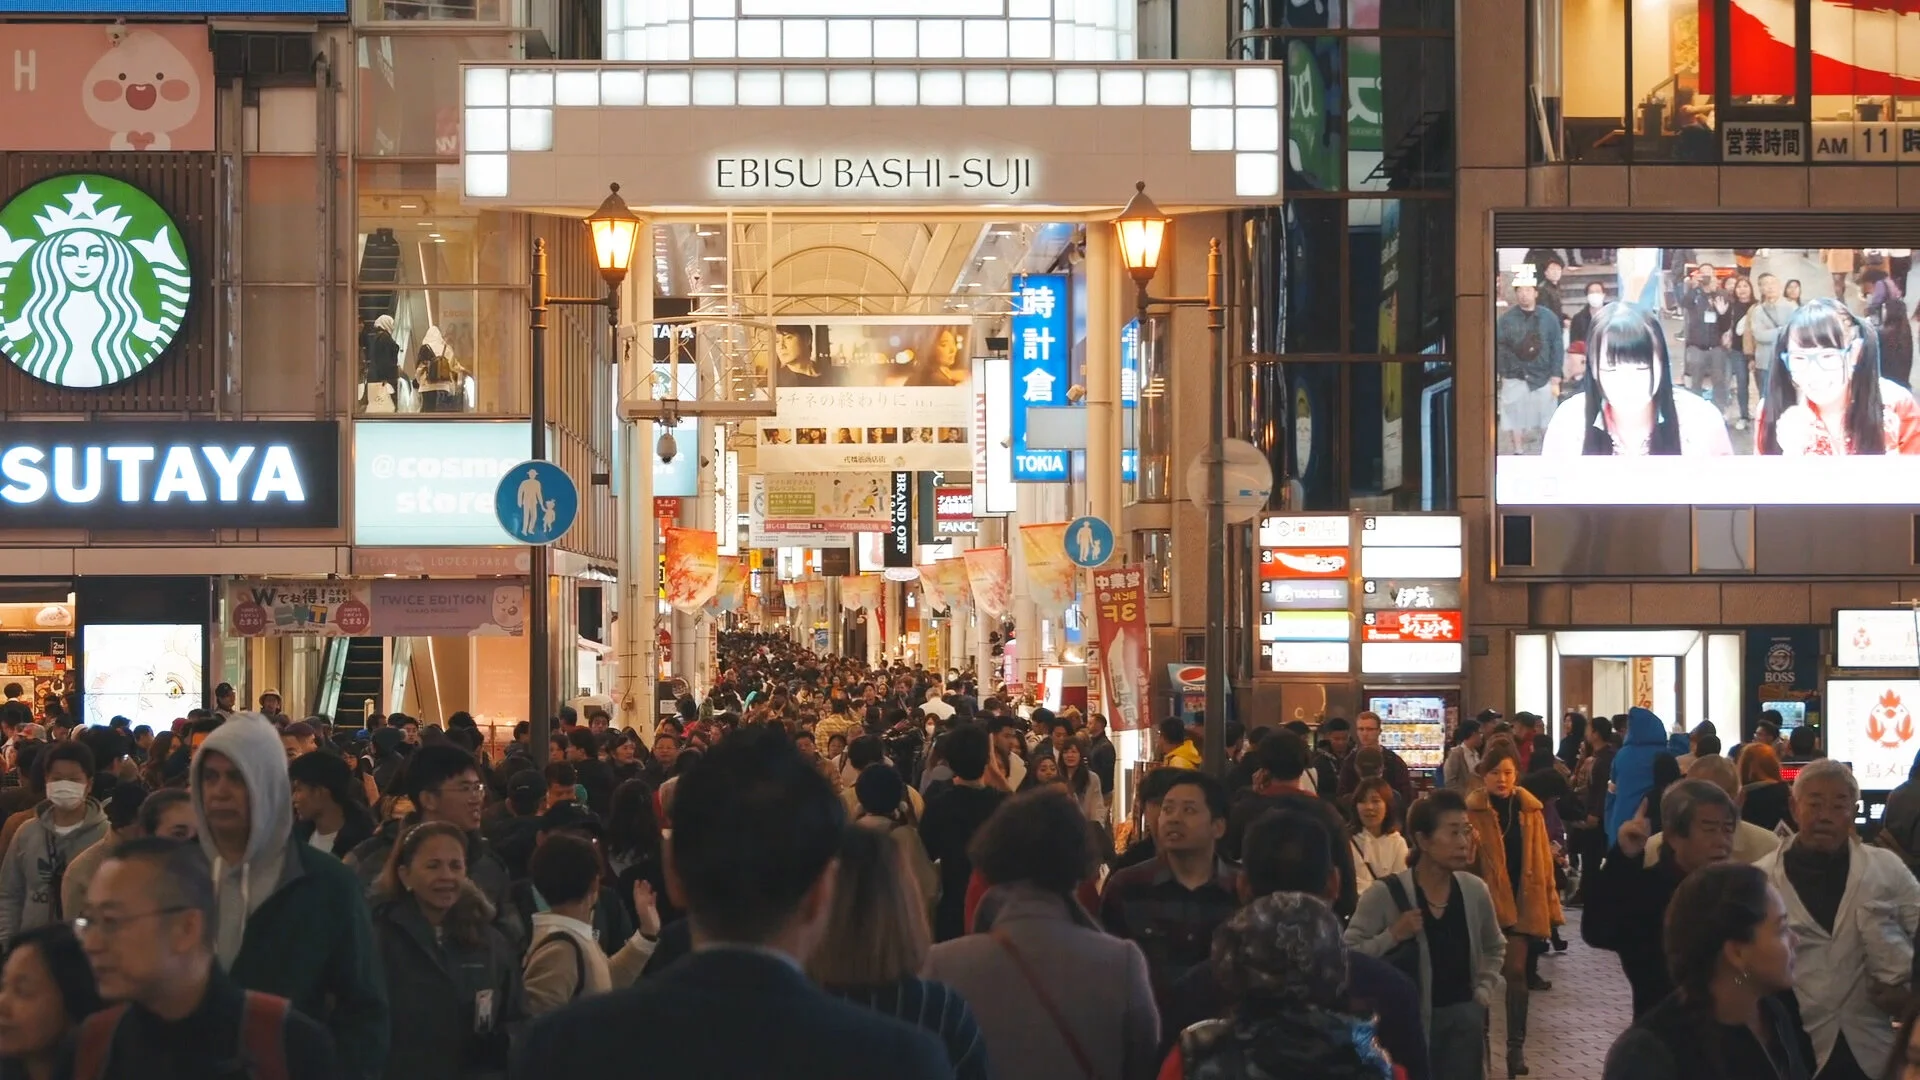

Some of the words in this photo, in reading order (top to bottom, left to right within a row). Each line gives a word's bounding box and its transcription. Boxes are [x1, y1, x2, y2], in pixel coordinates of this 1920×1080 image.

[1726, 127, 1800, 156] 営業時間
[1817, 138, 1848, 154] AM
[1862, 128, 1888, 153] 11
[716, 158, 823, 188] EBISU
[1020, 285, 1057, 452] 時計倉
[1016, 455, 1064, 473] TOKIA
[896, 473, 907, 522] BRAND
[938, 521, 979, 533] FANCL
[1364, 518, 1375, 529] 8
[896, 525, 907, 555] OFF
[1262, 551, 1272, 562] 3
[1262, 582, 1271, 592] 2
[1364, 582, 1375, 593] 6
[380, 595, 424, 605] TWICE
[429, 594, 486, 605] EDITION
[1263, 613, 1271, 624] 1
[1364, 613, 1375, 624] 5
[1764, 672, 1796, 683] BOSS
